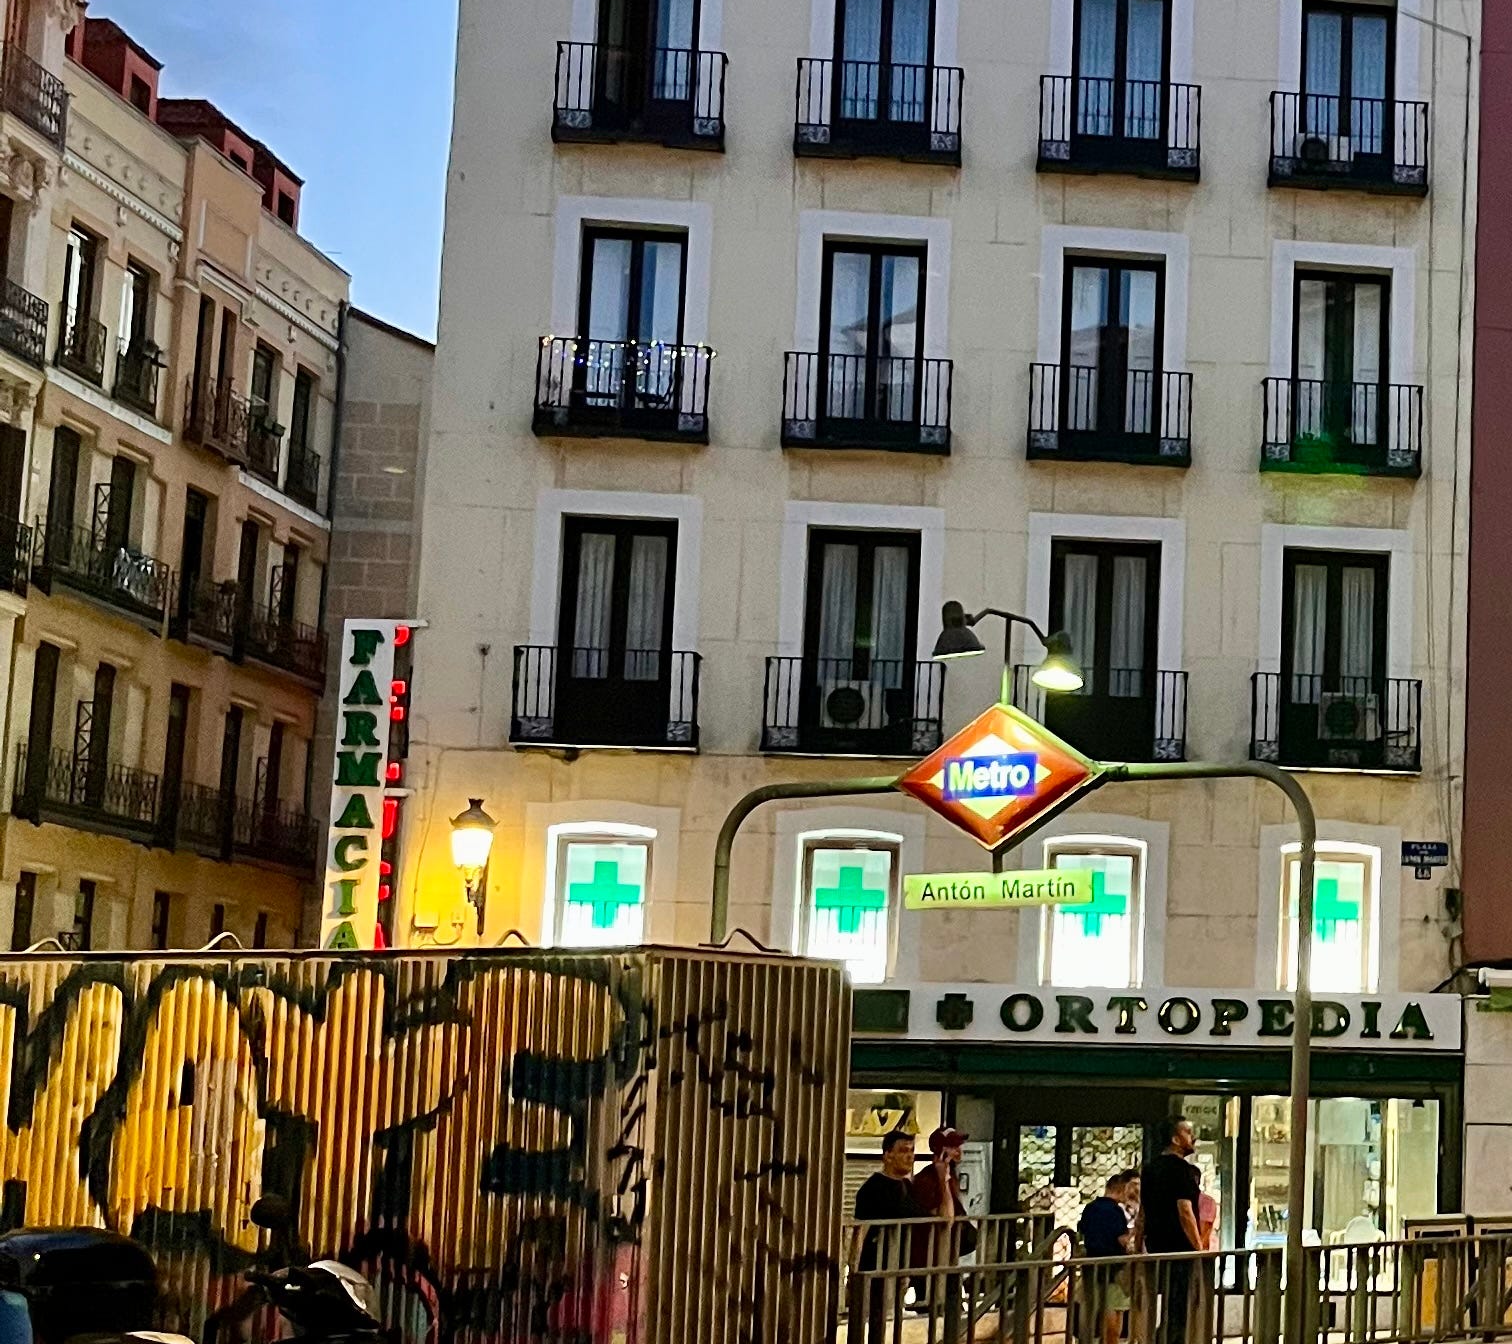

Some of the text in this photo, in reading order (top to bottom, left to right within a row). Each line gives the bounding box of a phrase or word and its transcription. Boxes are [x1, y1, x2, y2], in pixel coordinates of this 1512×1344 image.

[333, 629, 385, 949] FARMACIA
[949, 760, 1030, 792] Metro
[921, 876, 1075, 902] Antón Martín
[1000, 993, 1435, 1041] ORTOPEDIA
